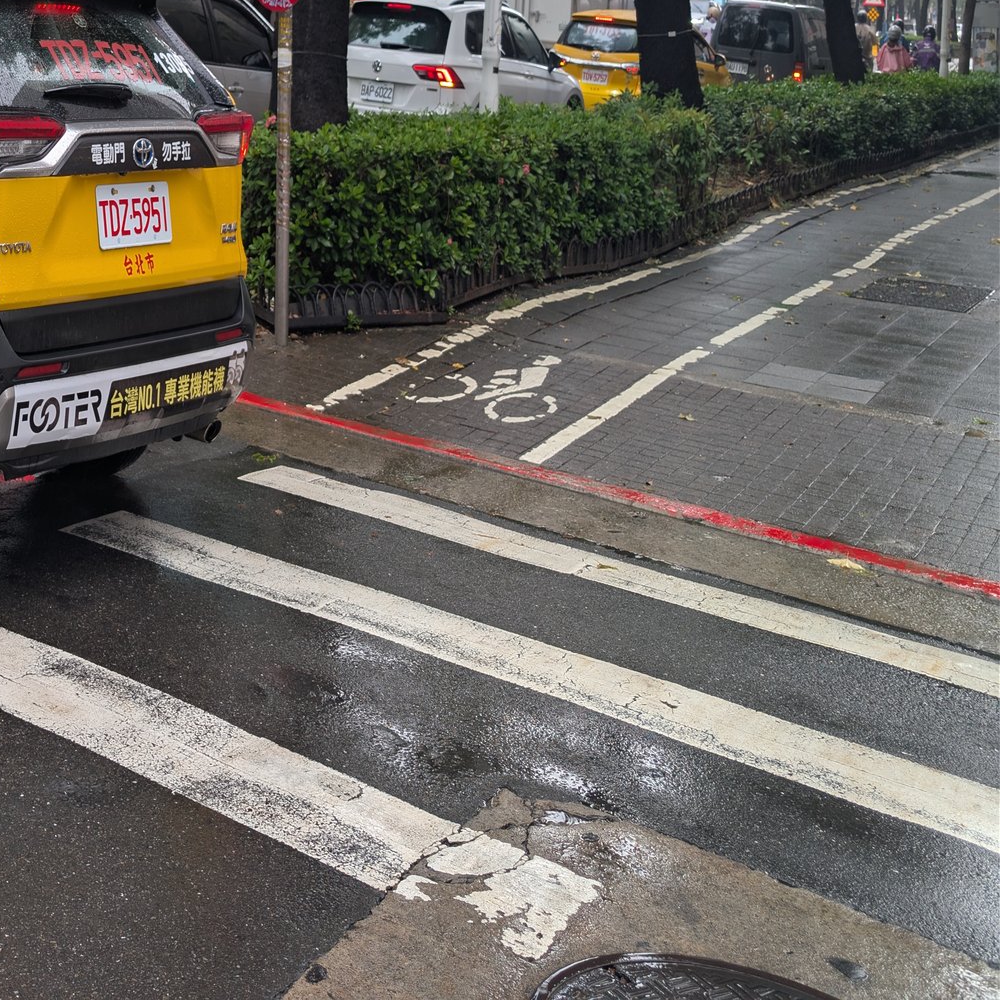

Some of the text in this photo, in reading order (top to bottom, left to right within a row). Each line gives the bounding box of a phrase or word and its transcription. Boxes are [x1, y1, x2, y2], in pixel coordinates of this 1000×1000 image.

[39, 39, 163, 85] TDZ-5951
[360, 83, 393, 99] BAP-6022
[90, 141, 191, 166] 電動門 勿手拉
[99, 196, 168, 238] TDZ-5951
[123, 252, 155, 276] 台北市
[13, 388, 102, 437] FOOTER
[110, 366, 225, 419] 台灣NO.1 專業機能襪
